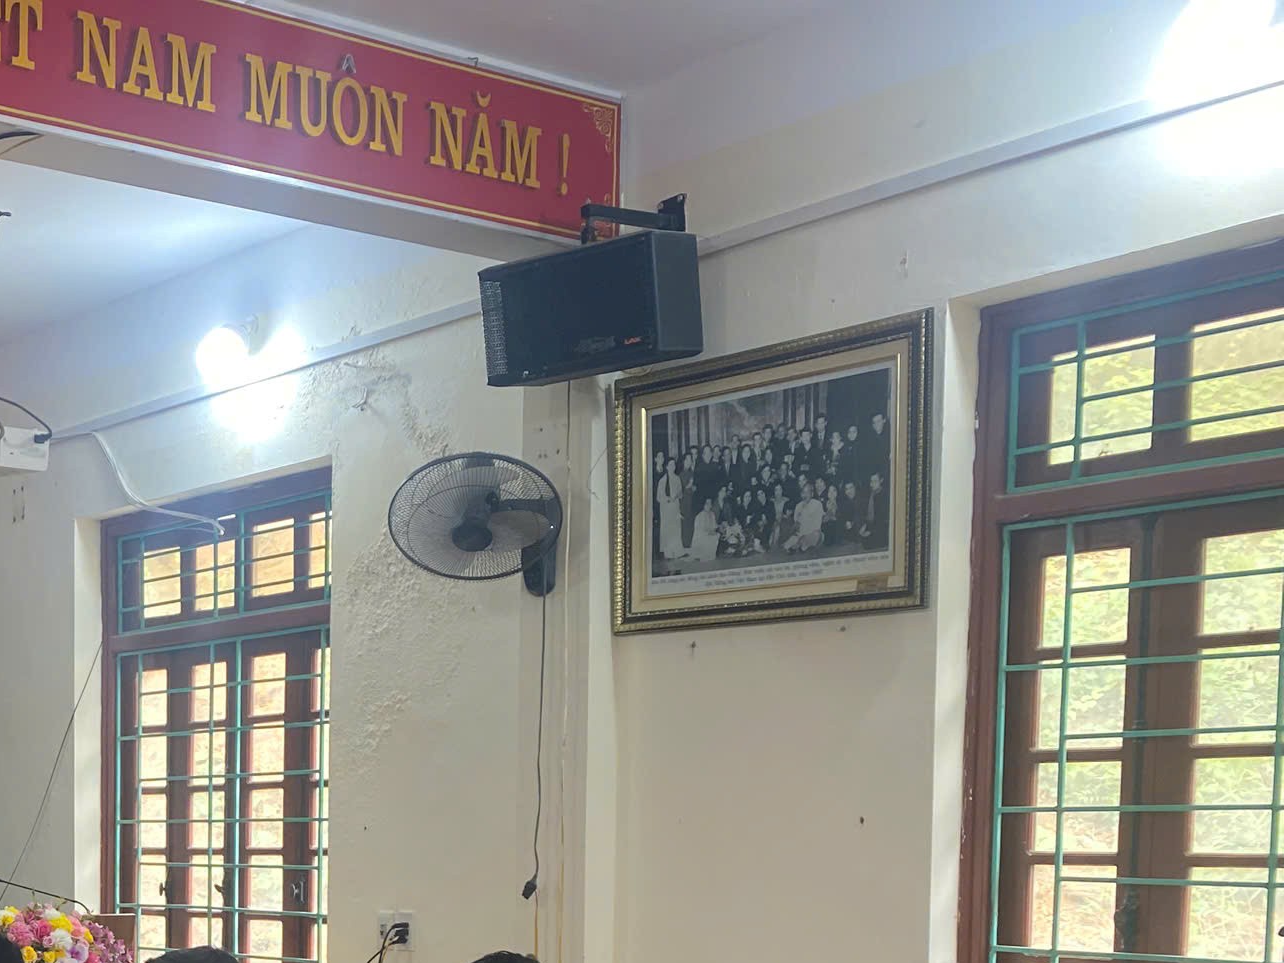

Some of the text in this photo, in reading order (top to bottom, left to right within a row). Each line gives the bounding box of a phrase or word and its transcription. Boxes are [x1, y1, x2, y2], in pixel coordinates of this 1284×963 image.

[76, 10, 217, 113] NAM
[244, 53, 408, 156] MUÔN
[429, 90, 543, 190] NĂM
[557, 133, 571, 195] !
